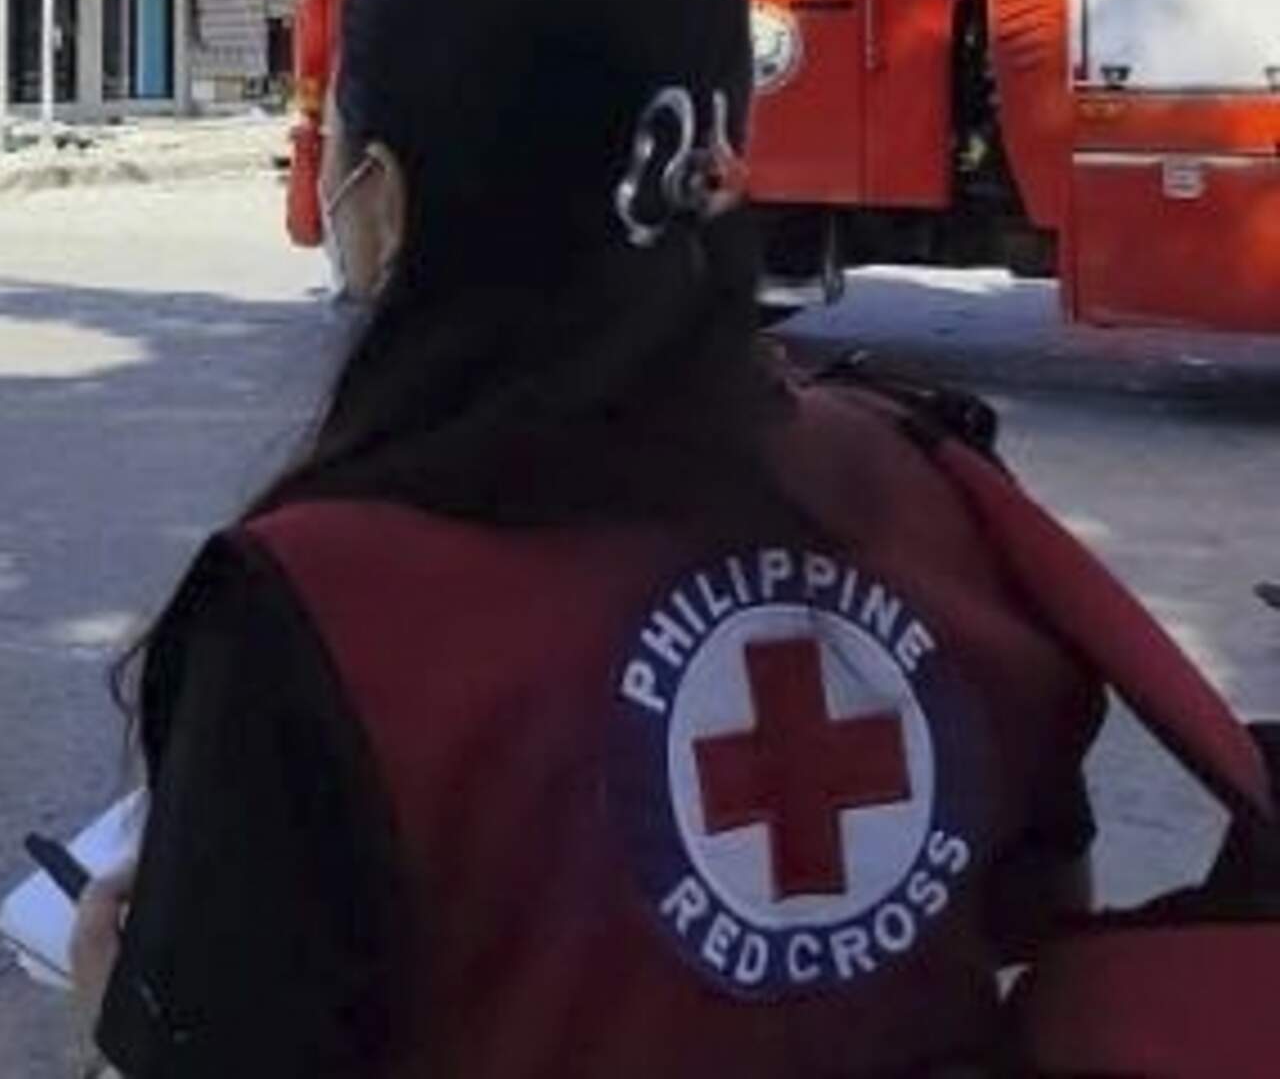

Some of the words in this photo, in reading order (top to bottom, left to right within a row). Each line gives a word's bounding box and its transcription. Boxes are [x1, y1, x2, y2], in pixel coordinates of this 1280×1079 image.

[620, 547, 936, 713] PHILIPPINE
[660, 875, 769, 985] RED
[786, 829, 971, 981] CROSS
